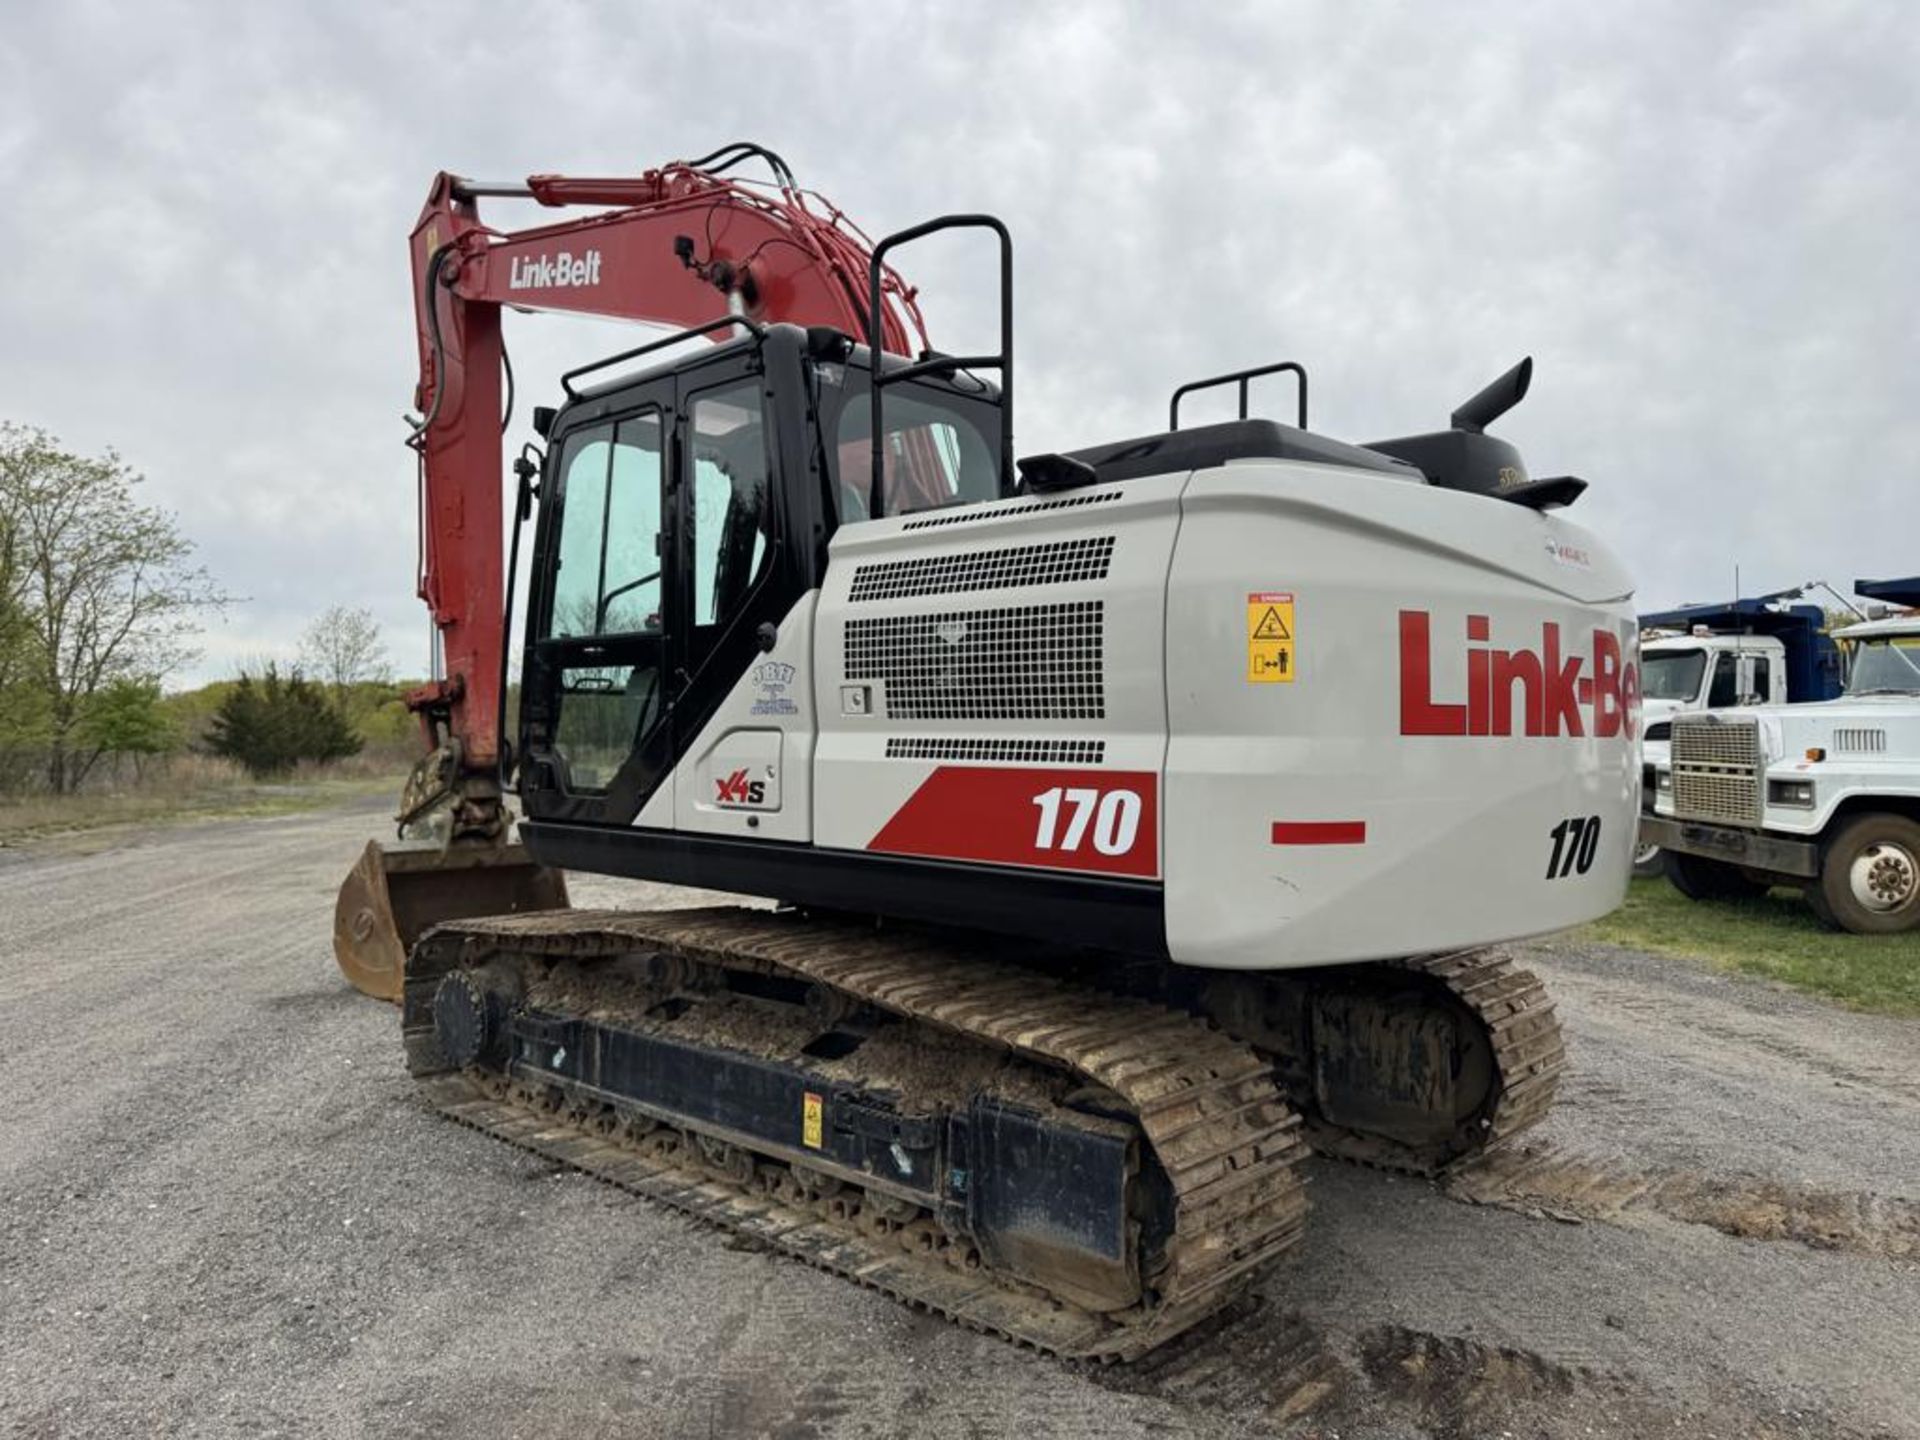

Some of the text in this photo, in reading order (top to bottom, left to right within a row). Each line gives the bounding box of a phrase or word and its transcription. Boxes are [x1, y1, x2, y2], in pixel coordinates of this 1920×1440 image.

[509, 250, 601, 289] Link-Belt
[1032, 787, 1141, 855] 170
[1546, 816, 1601, 880] 170
